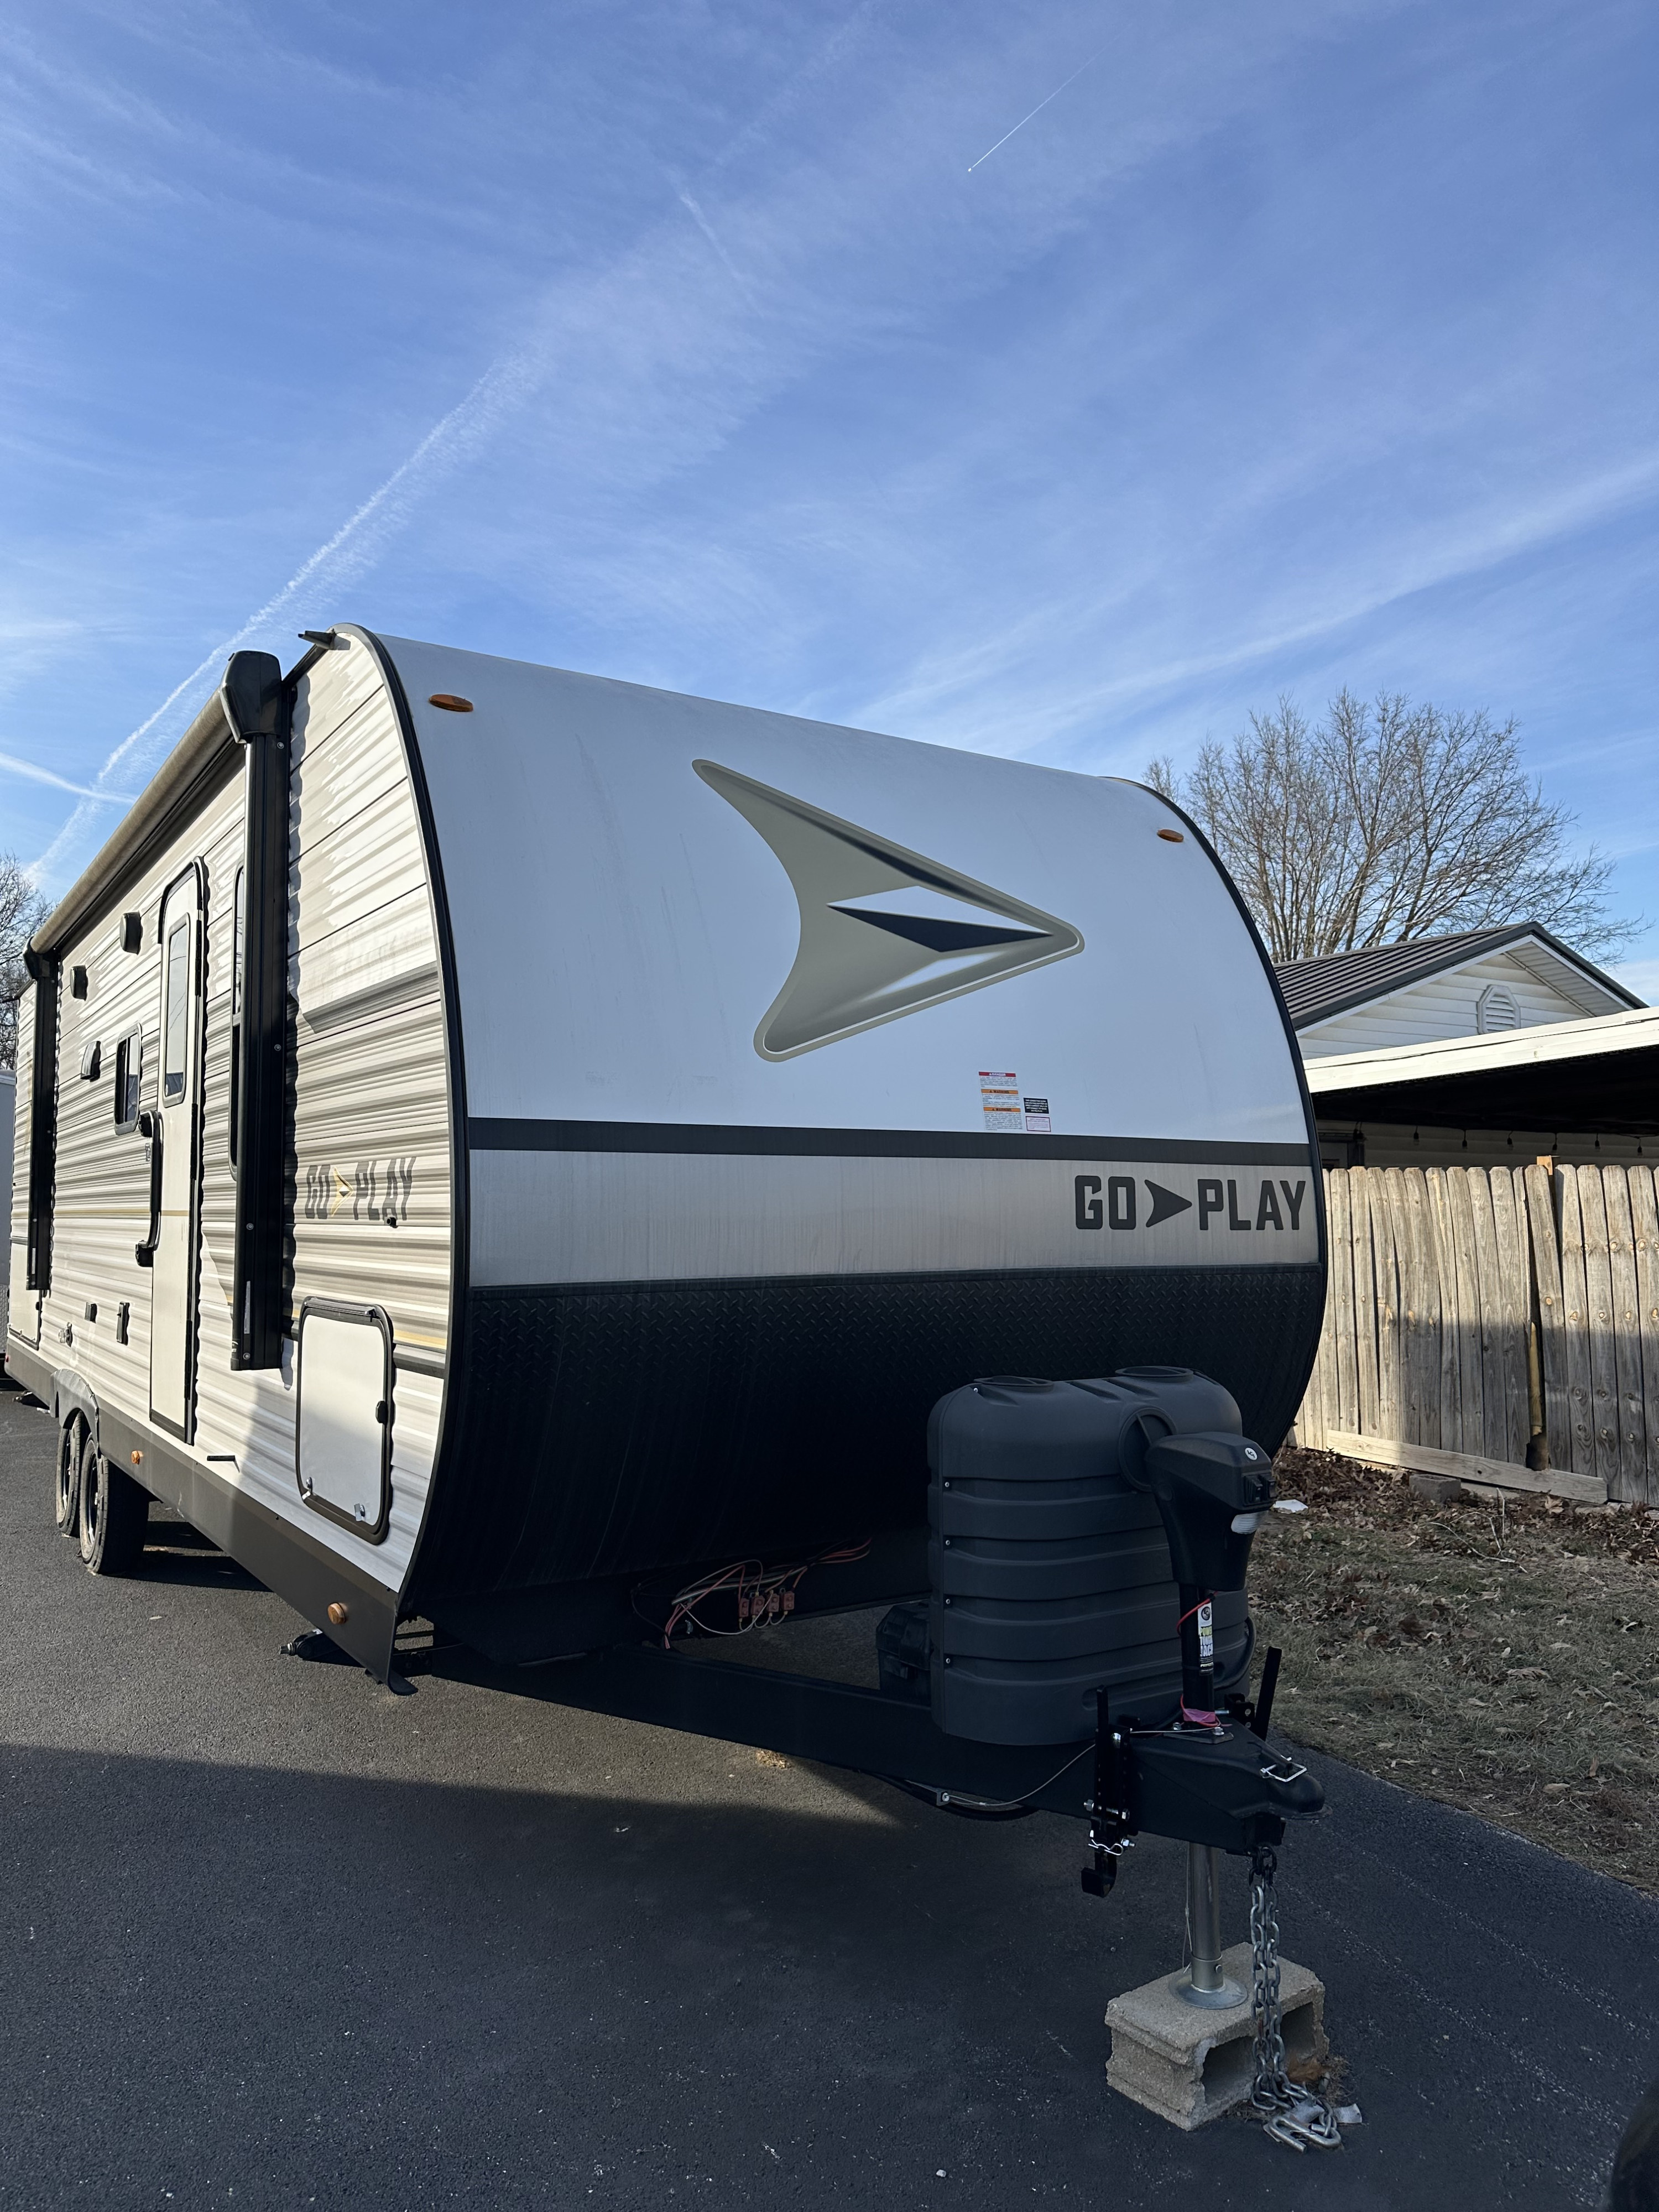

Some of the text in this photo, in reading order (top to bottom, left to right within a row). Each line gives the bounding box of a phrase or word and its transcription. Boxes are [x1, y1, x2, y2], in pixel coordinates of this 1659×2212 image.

[305, 1156, 417, 1220] GO PLAY
[1074, 1175, 1306, 1230] GO PLAY
